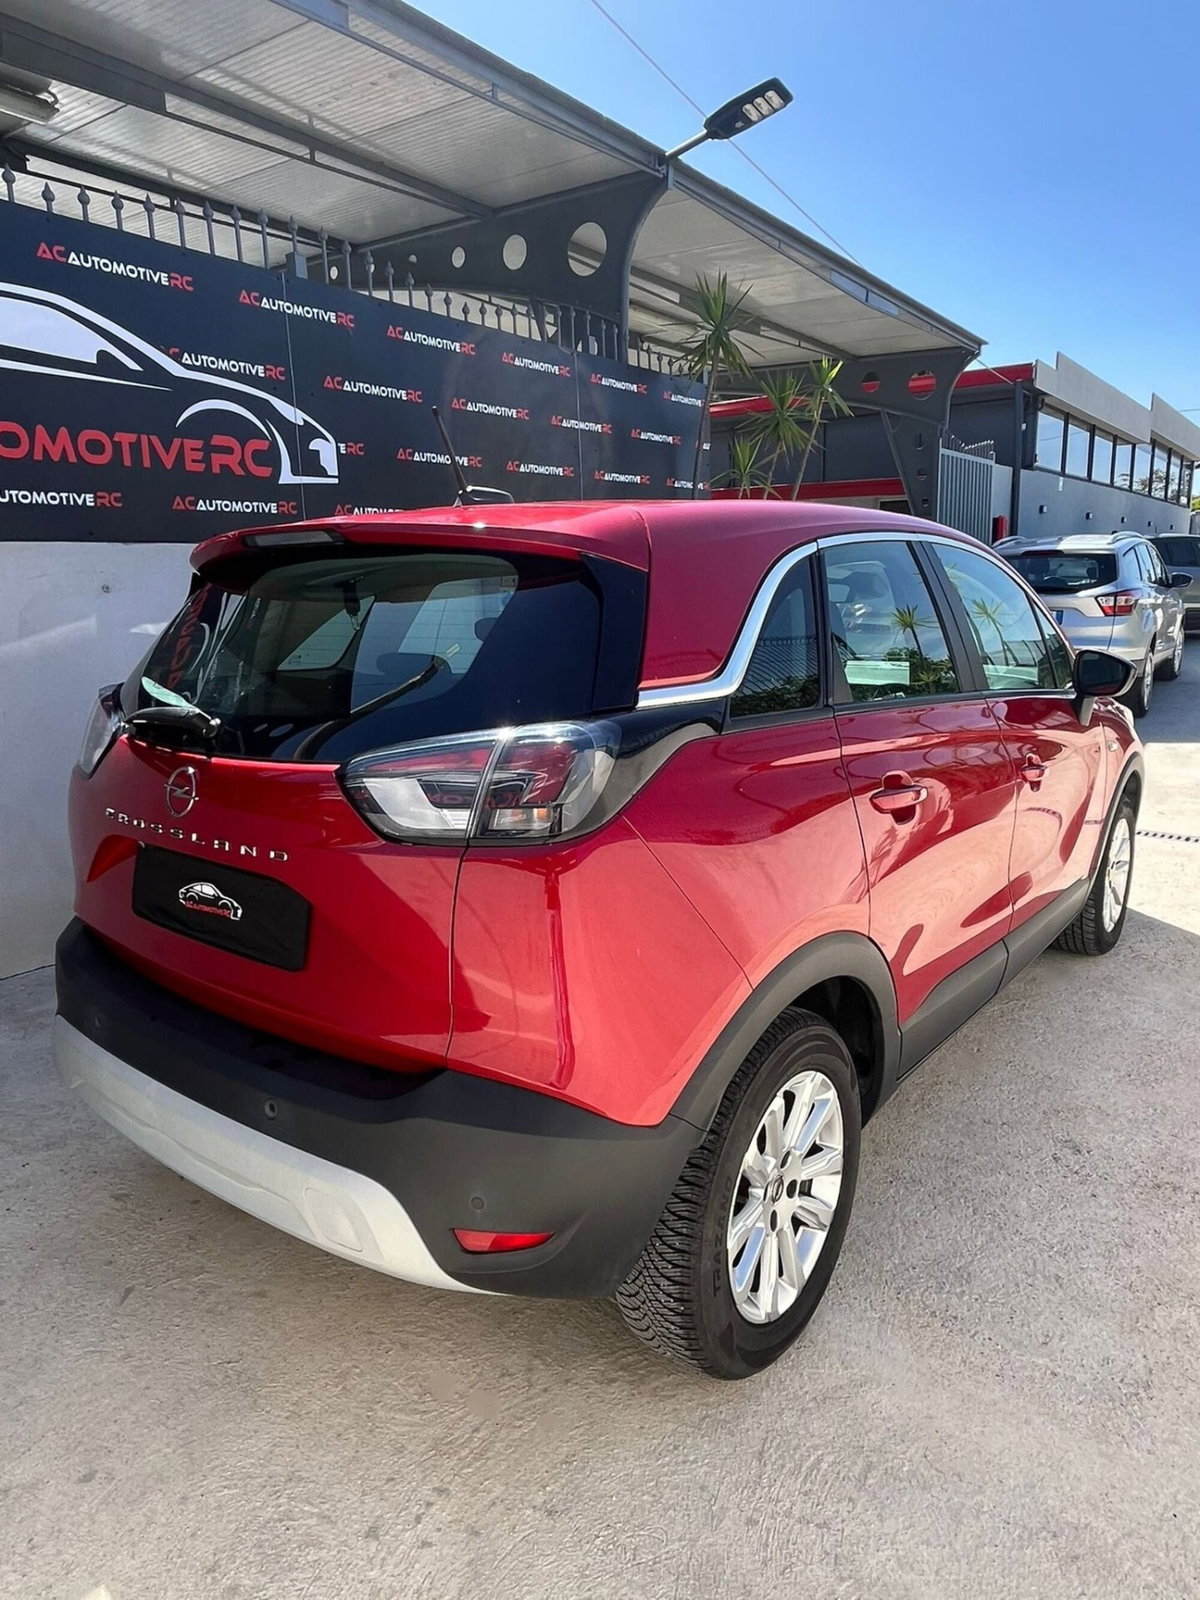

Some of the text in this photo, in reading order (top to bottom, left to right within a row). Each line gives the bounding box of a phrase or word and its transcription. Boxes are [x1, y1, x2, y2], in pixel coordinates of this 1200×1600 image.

[35, 241, 194, 292] ACAUTOMOTIVERC
[239, 290, 355, 328] ACAUTOMOTIVERC
[387, 325, 476, 355] ACAUTOMOTIVERC
[501, 352, 571, 377] ACAUTOMOTIVERC
[323, 376, 422, 403] ACAUTOMOTIVERC
[590, 373, 648, 394] ACAUTOMOTIVERC
[451, 398, 530, 420] ACAUTOMOTIVERC
[550, 415, 612, 435] ACAUTOMOTIVERC
[631, 429, 682, 445] ACAUTOMOTIVERC
[0, 422, 273, 478] OMOTIVERC
[506, 460, 574, 478] ACAUTOMOTIVERC
[594, 470, 651, 485] ACAUTOMOTIVERC
[172, 495, 298, 515] ACAUTOMOTIVERC
[105, 808, 288, 862] CROSSLAND
